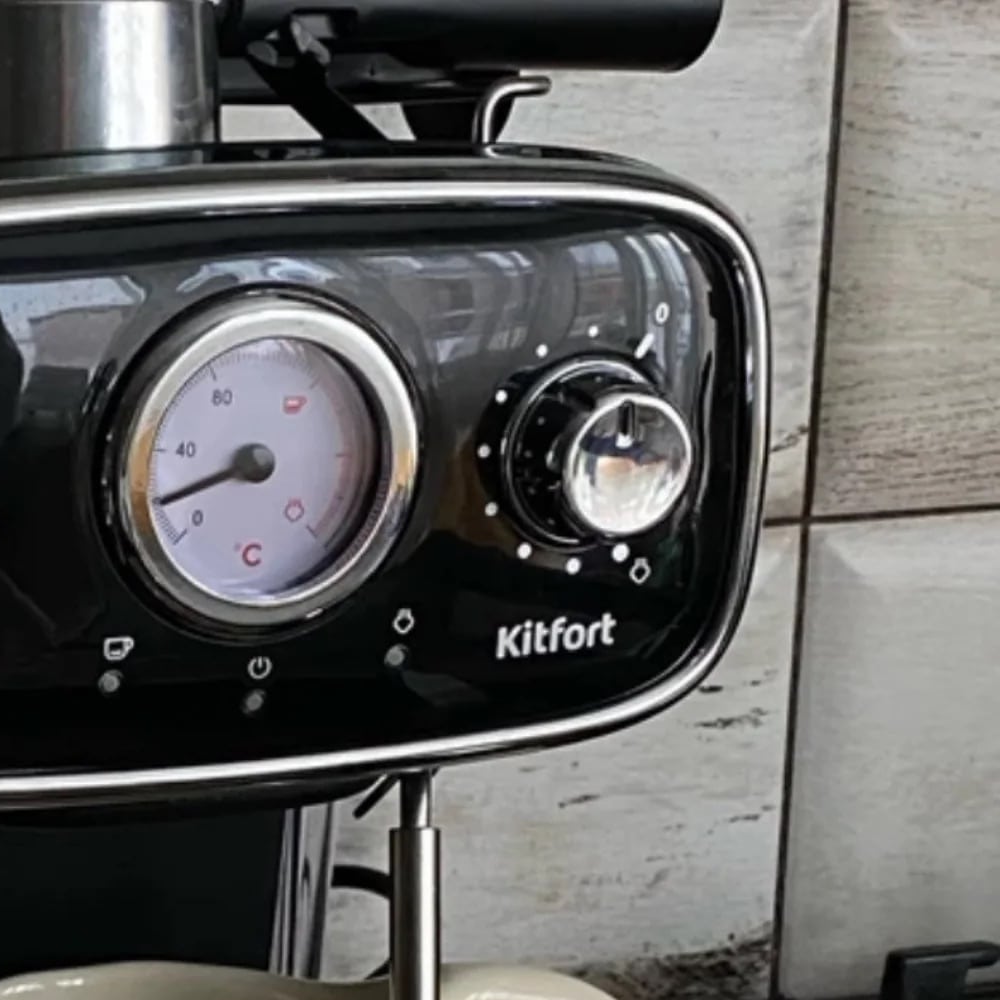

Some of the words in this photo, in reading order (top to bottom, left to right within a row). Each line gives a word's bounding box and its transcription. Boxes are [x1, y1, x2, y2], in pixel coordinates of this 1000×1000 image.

[211, 388, 233, 406] 80
[175, 441, 197, 458] 40
[190, 508, 204, 526] 0
[495, 612, 617, 659] Kitfort
